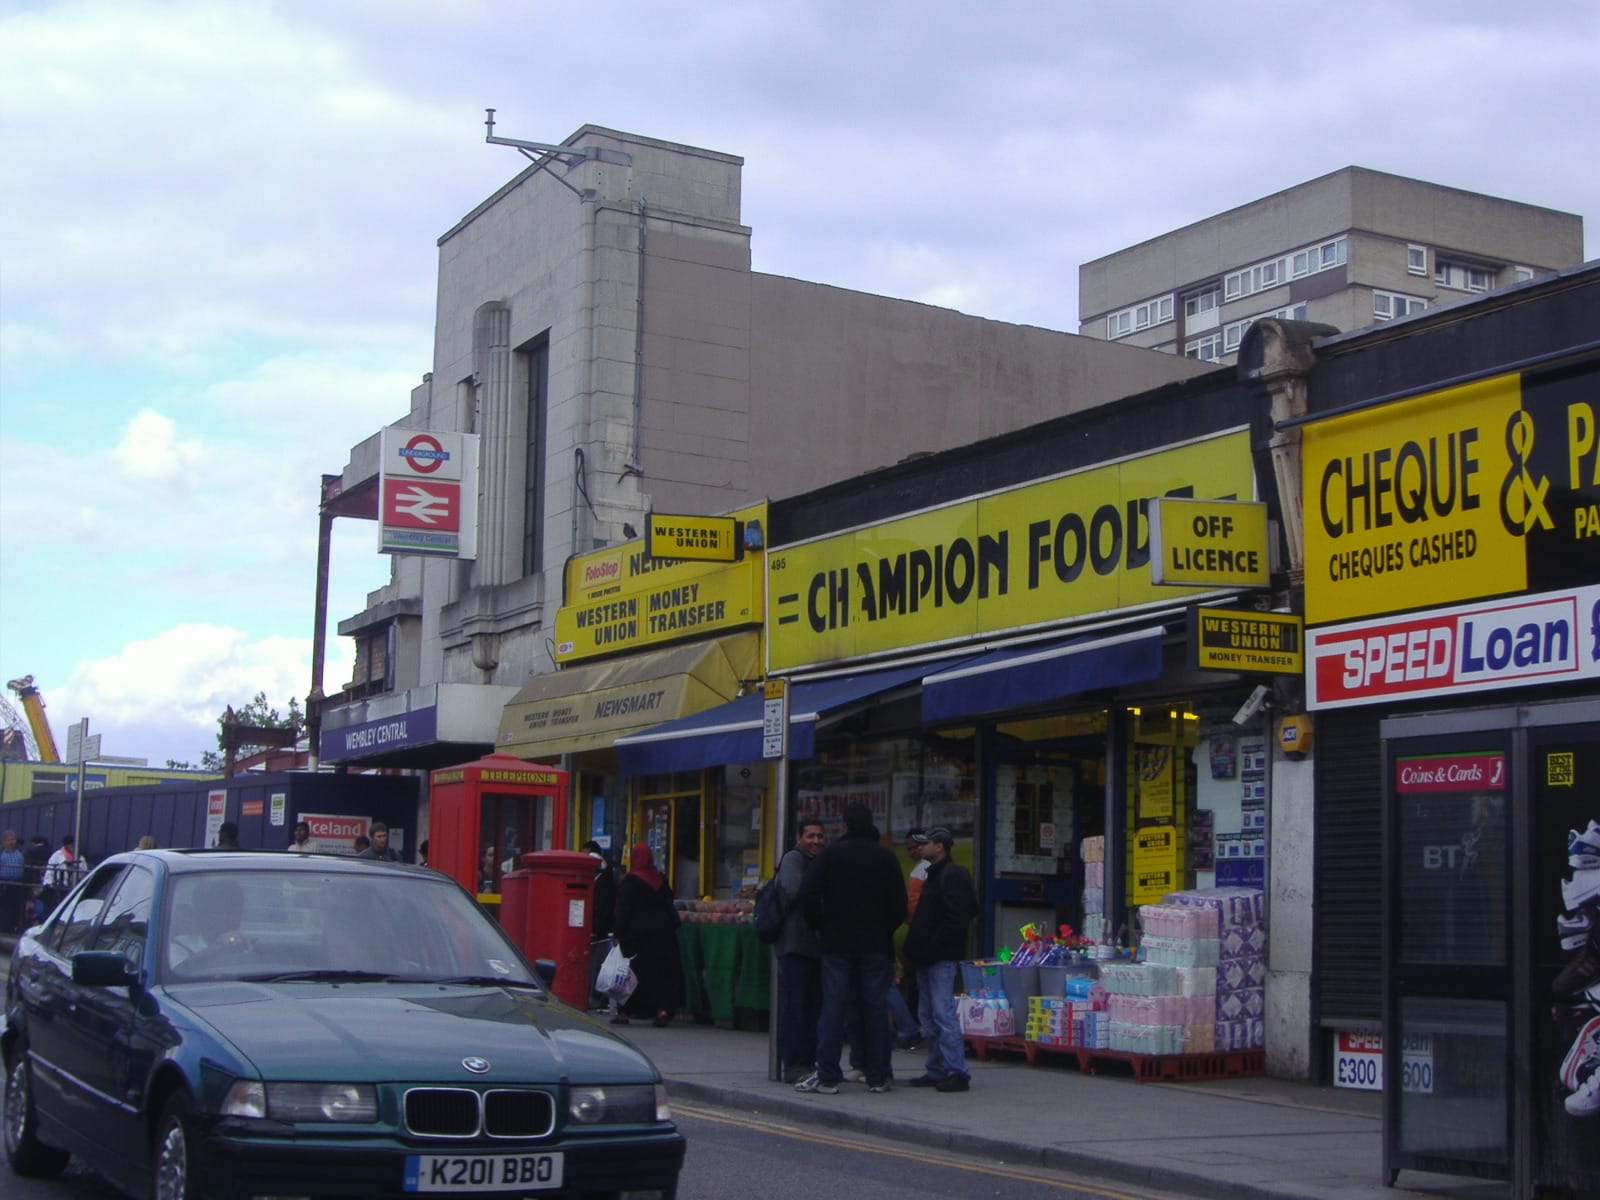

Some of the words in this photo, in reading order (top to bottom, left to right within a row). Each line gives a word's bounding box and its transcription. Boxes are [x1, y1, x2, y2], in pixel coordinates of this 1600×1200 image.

[401, 450, 448, 459] UNDERGROUND
[1321, 427, 1480, 538] CHEQUE
[1500, 410, 1554, 537] &
[1567, 402, 1600, 490] P
[655, 526, 718, 539] WESTERN
[1192, 515, 1234, 539] OFF
[1575, 504, 1600, 539] PA
[676, 538, 718, 549] UNION
[1329, 541, 1404, 582] CHEQUES
[1409, 529, 1477, 565] CASHED
[771, 558, 786, 571] 495
[807, 530, 1009, 634] CHAMPION
[1028, 485, 1193, 590] FOOD
[1172, 547, 1259, 573] LICENCE
[576, 598, 637, 628] WESTERN
[650, 584, 699, 612] MONEY
[594, 620, 637, 645] UNION
[650, 600, 725, 634] TRANSFER
[1204, 618, 1280, 636] WESTERN
[1231, 634, 1280, 650] UNION
[1342, 626, 1453, 689] SPEED
[1461, 618, 1569, 673] Loan
[1209, 651, 1242, 663] MONEY
[1246, 654, 1293, 666] TRANSFER
[593, 691, 666, 719] NEWSMART
[345, 728, 375, 750] WEMBLEY
[376, 721, 408, 745] CENTRAL
[486, 770, 553, 785] TELEPHONE
[1401, 766, 1433, 784] Coins
[1435, 767, 1446, 783] &
[1447, 763, 1483, 782] Cards
[309, 820, 361, 836] Iceland
[1423, 845, 1461, 869] BT
[1338, 1057, 1377, 1086] £300
